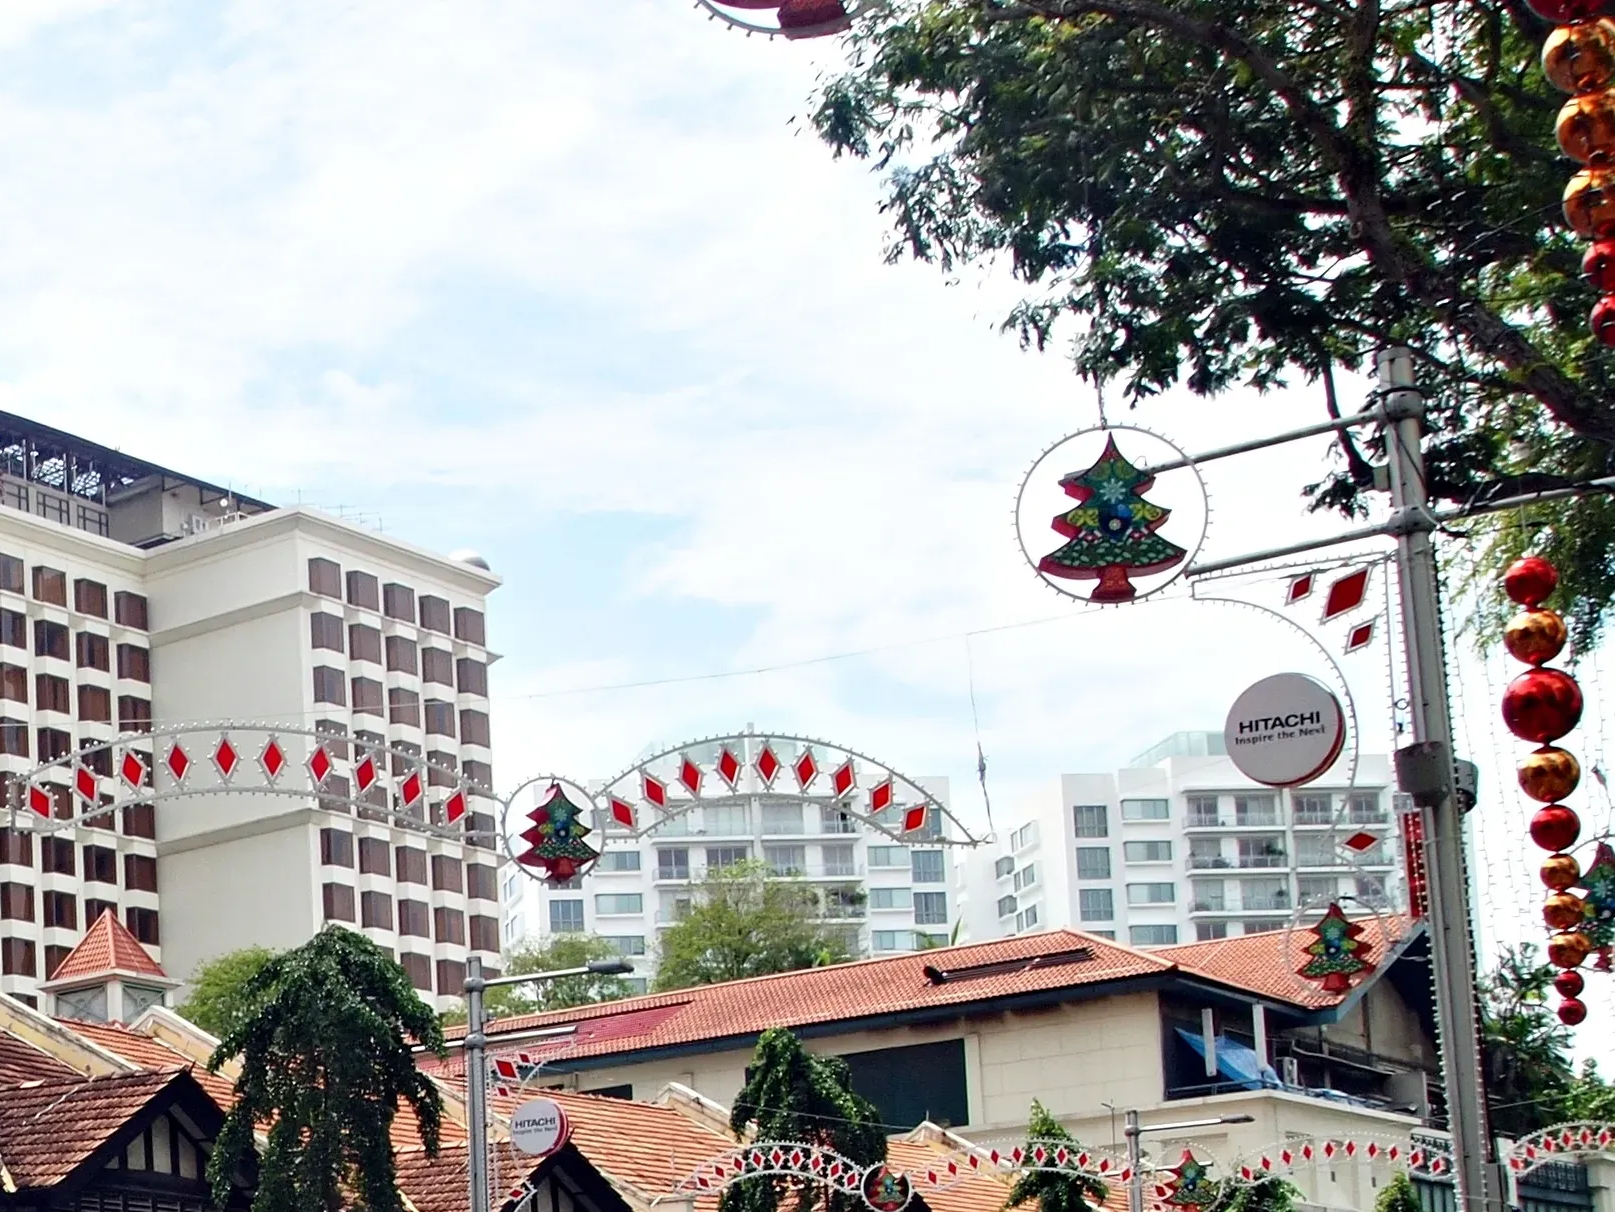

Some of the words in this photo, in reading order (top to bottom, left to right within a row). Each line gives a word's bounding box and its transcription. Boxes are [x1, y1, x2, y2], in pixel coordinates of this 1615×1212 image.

[1239, 711, 1321, 734] HITACHI
[1235, 733, 1274, 746] Inspire
[1278, 729, 1295, 740] the
[1299, 724, 1325, 737] Next
[515, 1117, 556, 1129] HITACHI
